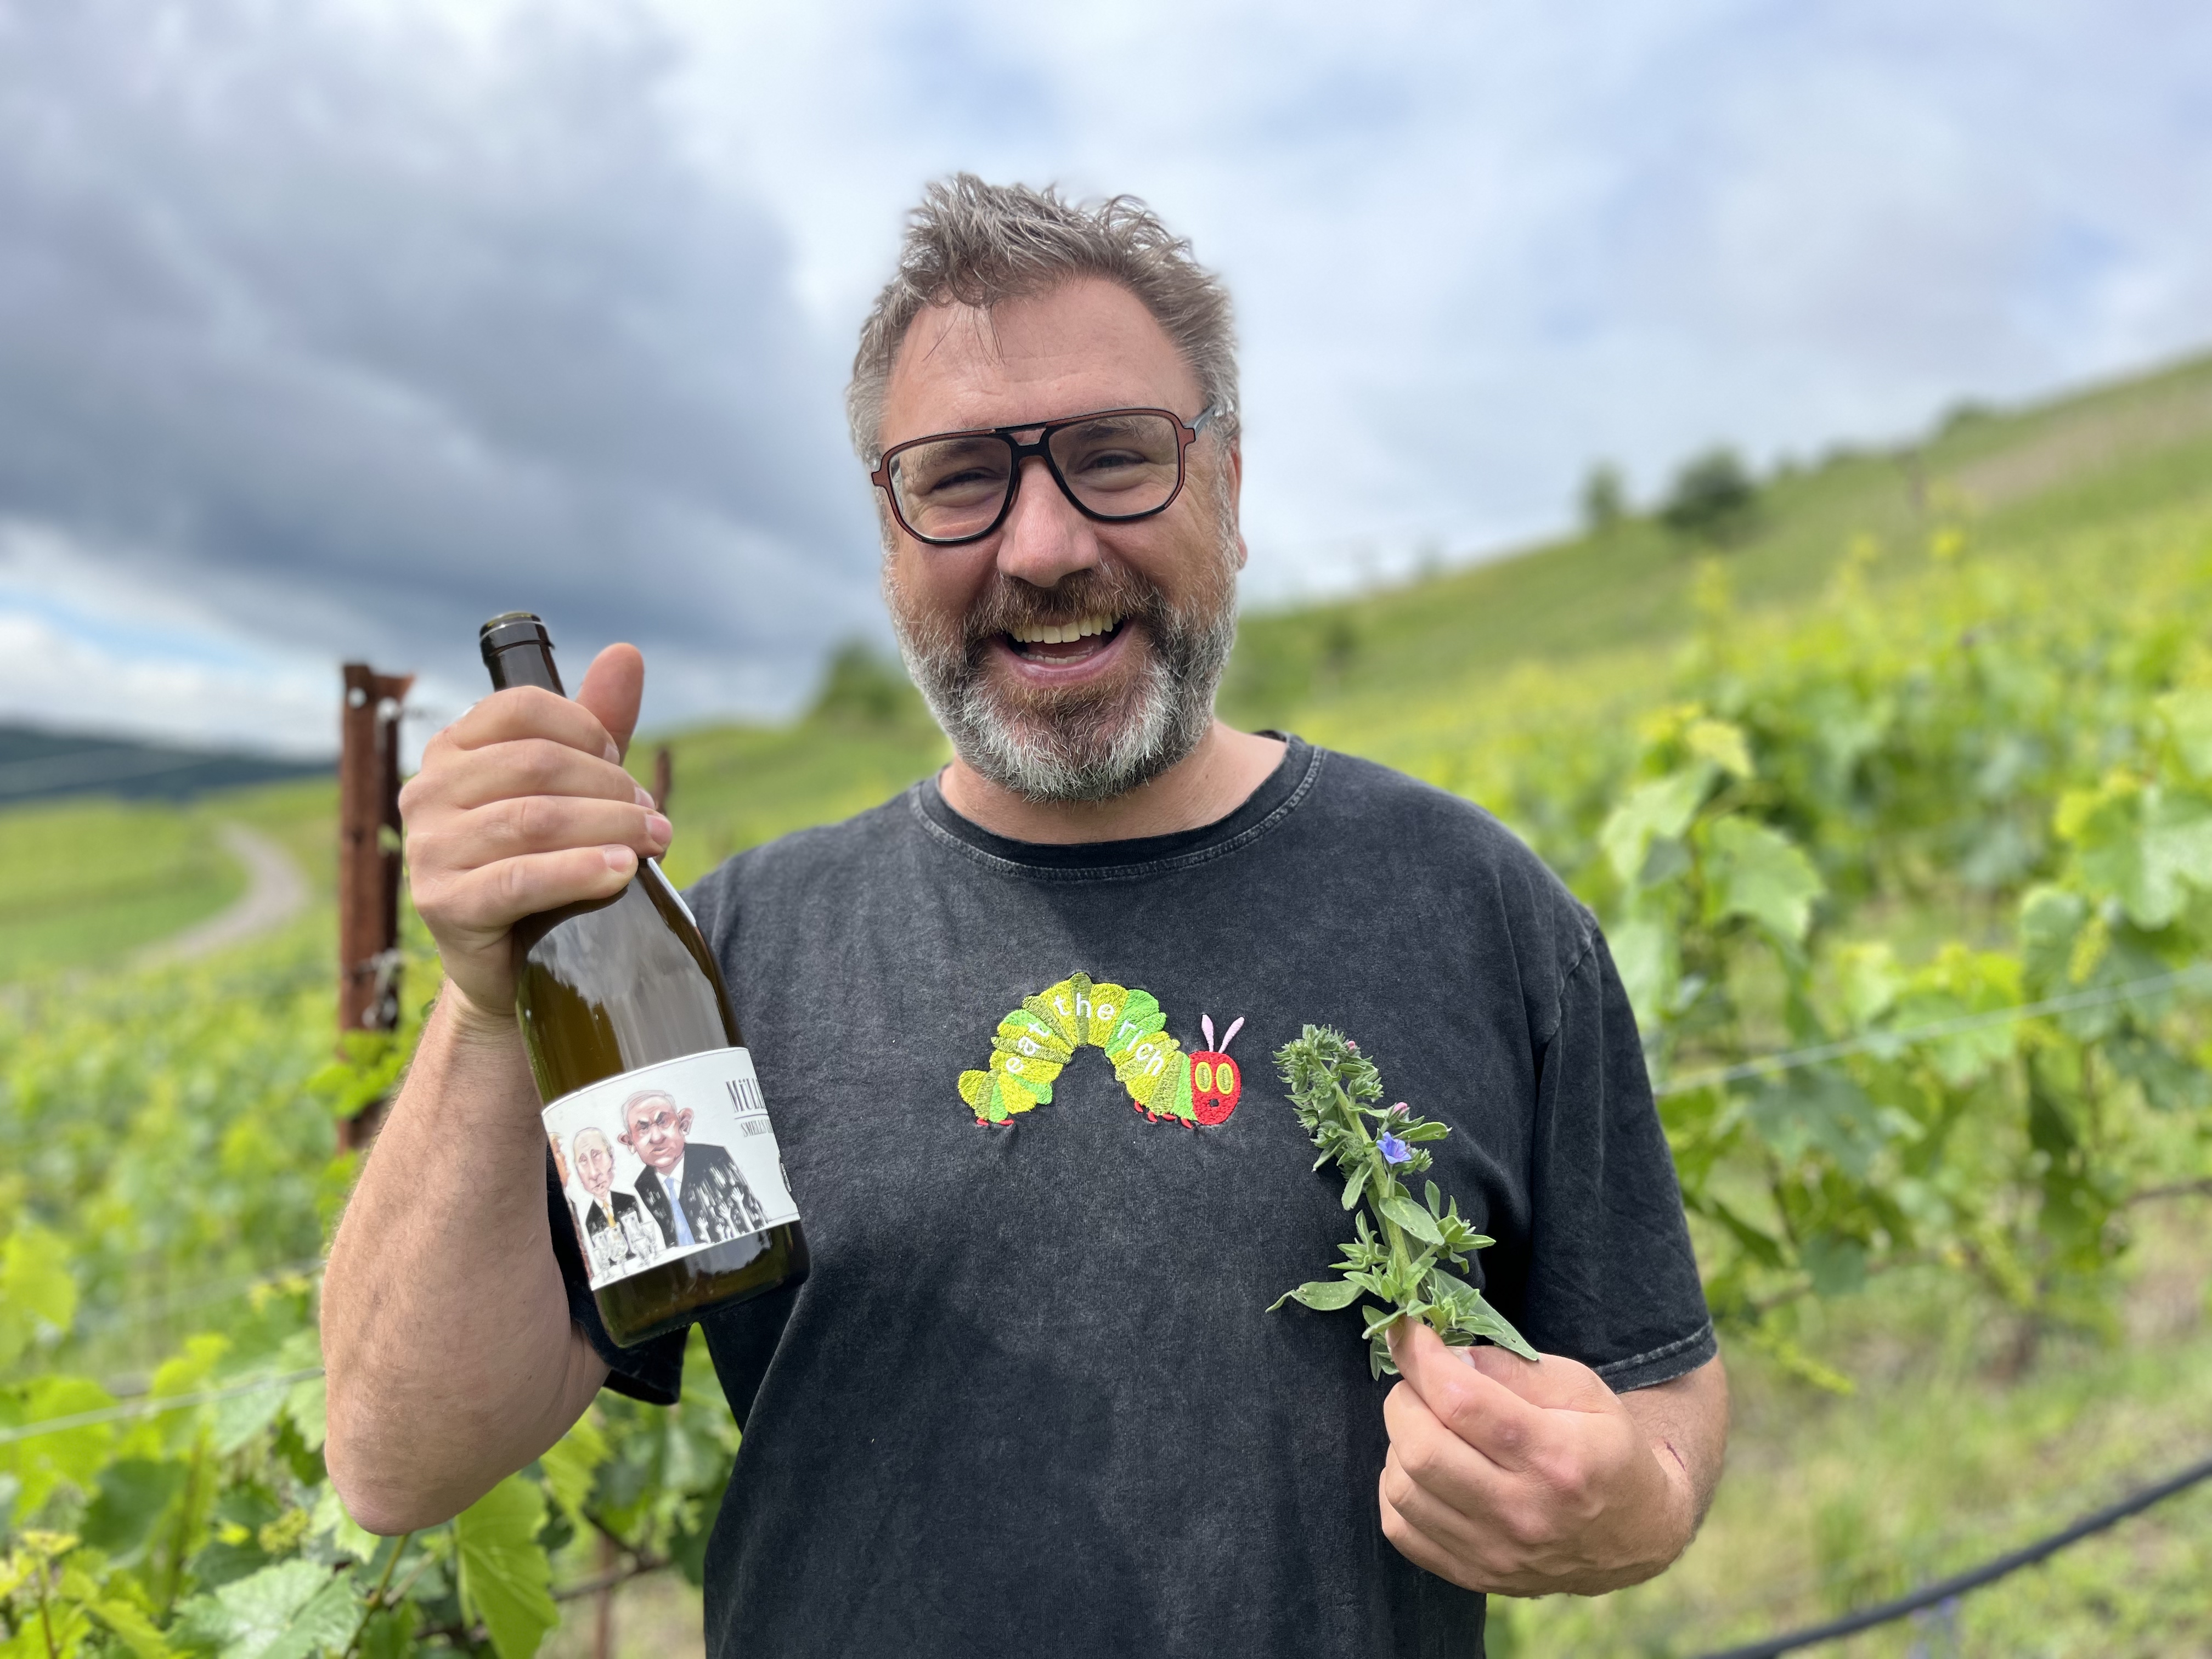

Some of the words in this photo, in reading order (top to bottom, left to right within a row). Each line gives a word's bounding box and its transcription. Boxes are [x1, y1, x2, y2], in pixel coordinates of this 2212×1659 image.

[1006, 1022, 1049, 1074] eat
[1053, 992, 1115, 1020] the
[1117, 1019, 1164, 1076] rich
